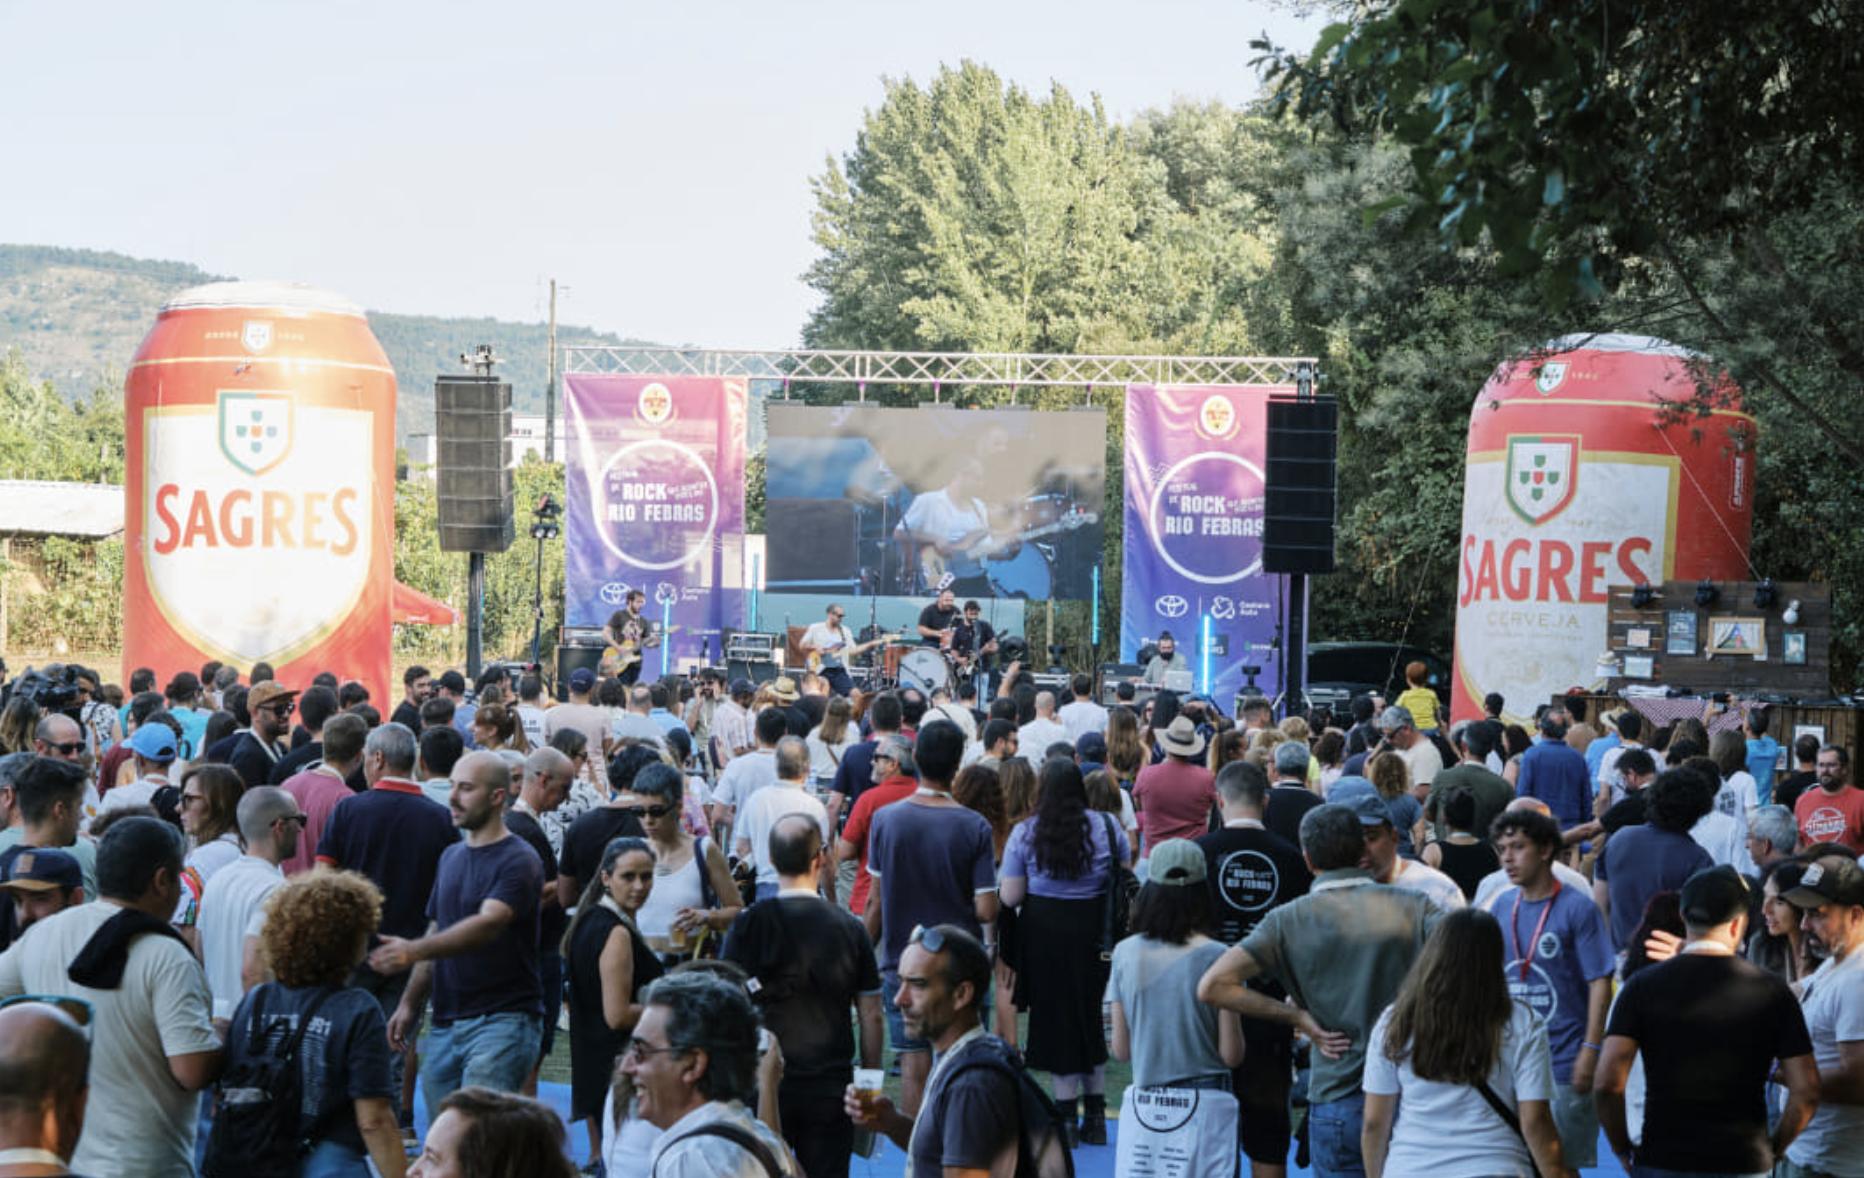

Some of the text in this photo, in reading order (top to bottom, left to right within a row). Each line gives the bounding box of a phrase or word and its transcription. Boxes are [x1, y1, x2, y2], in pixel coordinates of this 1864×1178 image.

[622, 482, 668, 501] ROCK
[607, 503, 705, 522] RIO FEBRAS
[1180, 494, 1227, 515] ROCK
[154, 483, 359, 556] SAGRES
[1165, 515, 1265, 537] RIO FEBRAS
[1460, 534, 1652, 608] SAGRES
